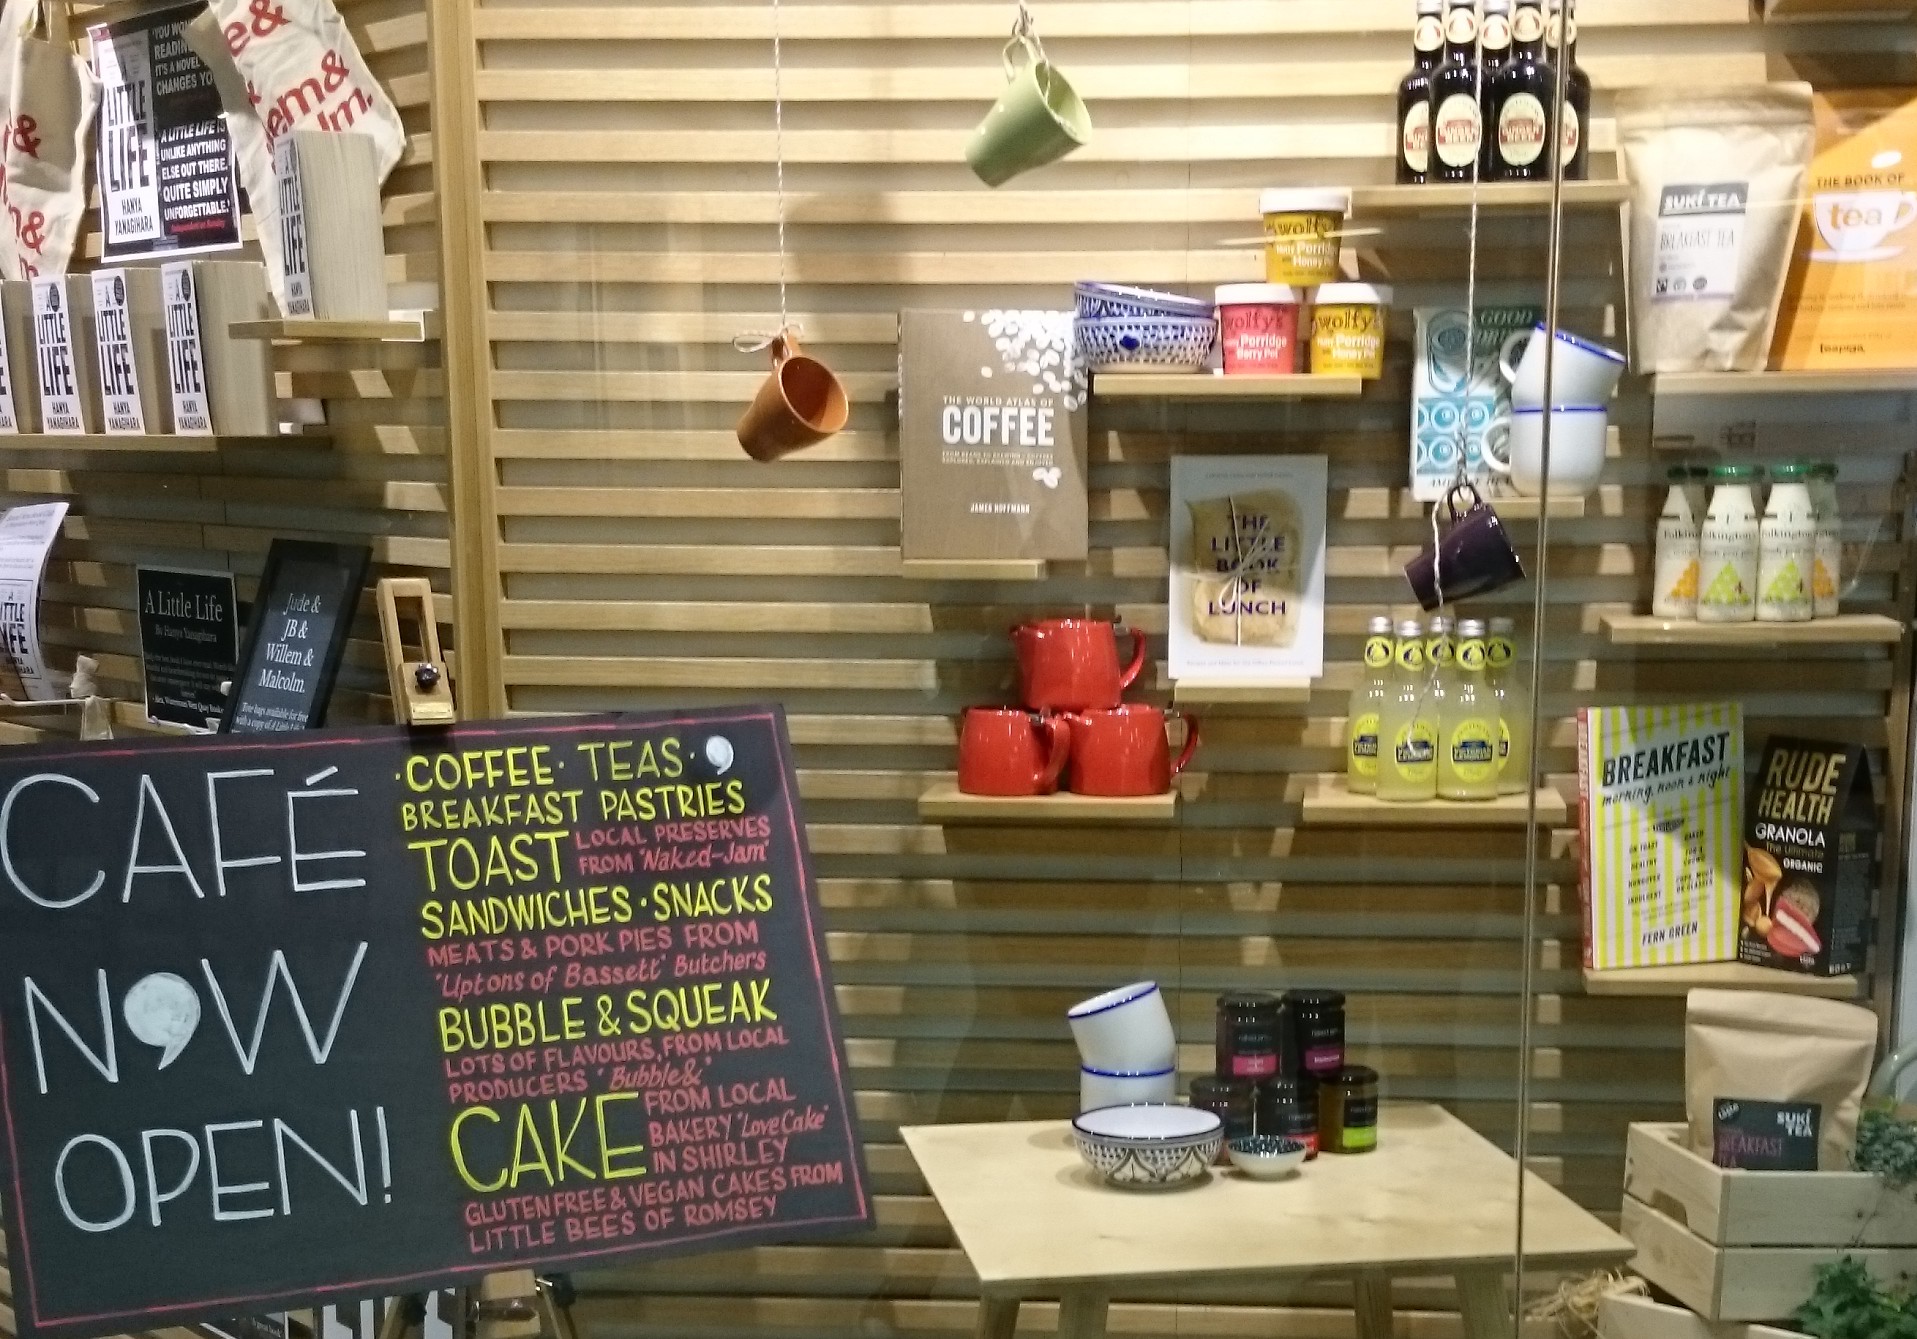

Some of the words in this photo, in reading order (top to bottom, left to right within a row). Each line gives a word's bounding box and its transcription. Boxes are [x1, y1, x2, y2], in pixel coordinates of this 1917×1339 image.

[156, 75, 198, 96] CHANGES
[169, 123, 194, 141] LITTLE
[195, 119, 216, 137] LIFE
[108, 122, 150, 192] LIFE
[160, 144, 186, 162] UNLIKE
[186, 138, 227, 157] ANYTHING
[161, 164, 181, 181] ELSE
[182, 161, 197, 178] OUT
[197, 157, 229, 175] THERE.
[1816, 175, 1842, 189] THE
[1844, 173, 1883, 188] BOOK
[1887, 173, 1906, 186] OF
[121, 197, 143, 215] HANYA
[163, 181, 192, 203] QUITE
[193, 176, 229, 197] SIMPLY
[1706, 191, 1742, 209] TEA
[114, 215, 154, 237] YANAGIHARA
[1828, 202, 1884, 230] tea
[37, 312, 67, 345] LITTLE
[97, 308, 127, 342] LITTLE
[167, 302, 195, 338] LITTLE
[40, 345, 74, 396] LIFE
[100, 343, 135, 396] LIFE
[170, 338, 201, 394] LIFE
[943, 395, 962, 406] THE
[966, 395, 1003, 407] WORLD
[942, 405, 1055, 447] COFFEE
[1227, 514, 1271, 531] THE
[145, 589, 156, 615] A
[158, 591, 192, 620] Little
[195, 594, 223, 623] Life
[283, 592, 309, 616] Jude
[311, 595, 321, 614] &
[1208, 600, 1287, 616] LUNCH
[281, 618, 298, 642] JB
[298, 620, 308, 640] &
[266, 642, 302, 666] Willem
[303, 648, 314, 667] &
[258, 668, 306, 694] Malcolm.
[1602, 731, 1731, 788] BREAKFAST
[1765, 747, 1847, 796] RUDE
[1697, 765, 1731, 791] night
[401, 788, 584, 832] BREAKFAST
[601, 779, 746, 822] PASTRIES
[1757, 788, 1834, 826] HEALTH
[0, 765, 366, 909] CAFÉ
[575, 825, 647, 850] LOCAL
[654, 814, 772, 843] PRESERVES
[1755, 822, 1826, 848] GRANOLA
[407, 829, 571, 893] TOAST
[578, 850, 634, 876] FROM
[1783, 857, 1823, 874] ORGANIC
[419, 884, 633, 940] SANDWICHES
[652, 872, 774, 923] SNACKS
[426, 938, 515, 968] MEATS
[520, 936, 538, 960] &
[544, 930, 616, 959] PORK
[618, 924, 673, 953] PIES
[683, 918, 761, 949] FROM
[1641, 927, 1666, 947] FERN
[1668, 921, 1699, 942] GREEN
[529, 963, 559, 994] of
[673, 949, 768, 979] Butchers
[437, 996, 588, 1053] BUBBLE
[596, 993, 623, 1037] &
[626, 977, 778, 1035] SQUEAK
[443, 1053, 514, 1080] LOTS
[509, 1051, 538, 1075] OF
[661, 1030, 724, 1059] FROM
[726, 1024, 790, 1051] LOCAL
[448, 1068, 590, 1104] PRODUCERS
[643, 1088, 714, 1117] FROM
[718, 1077, 797, 1110] LOCAL
[449, 1090, 648, 1193] CAKE
[647, 1114, 734, 1148] BAKERY
[1785, 1123, 1814, 1138] TEA
[54, 1106, 392, 1232] OPEN!
[652, 1144, 678, 1175] IN
[682, 1136, 791, 1172] SHIRLEY
[610, 1187, 628, 1212] &
[628, 1174, 706, 1207] VEGAN
[711, 1167, 787, 1198] CAKES
[789, 1160, 844, 1189] FROM
[468, 1223, 556, 1254] LITTLE
[564, 1211, 637, 1244] BEES
[643, 1208, 675, 1233] OF
[684, 1193, 778, 1227] ROMSEY
